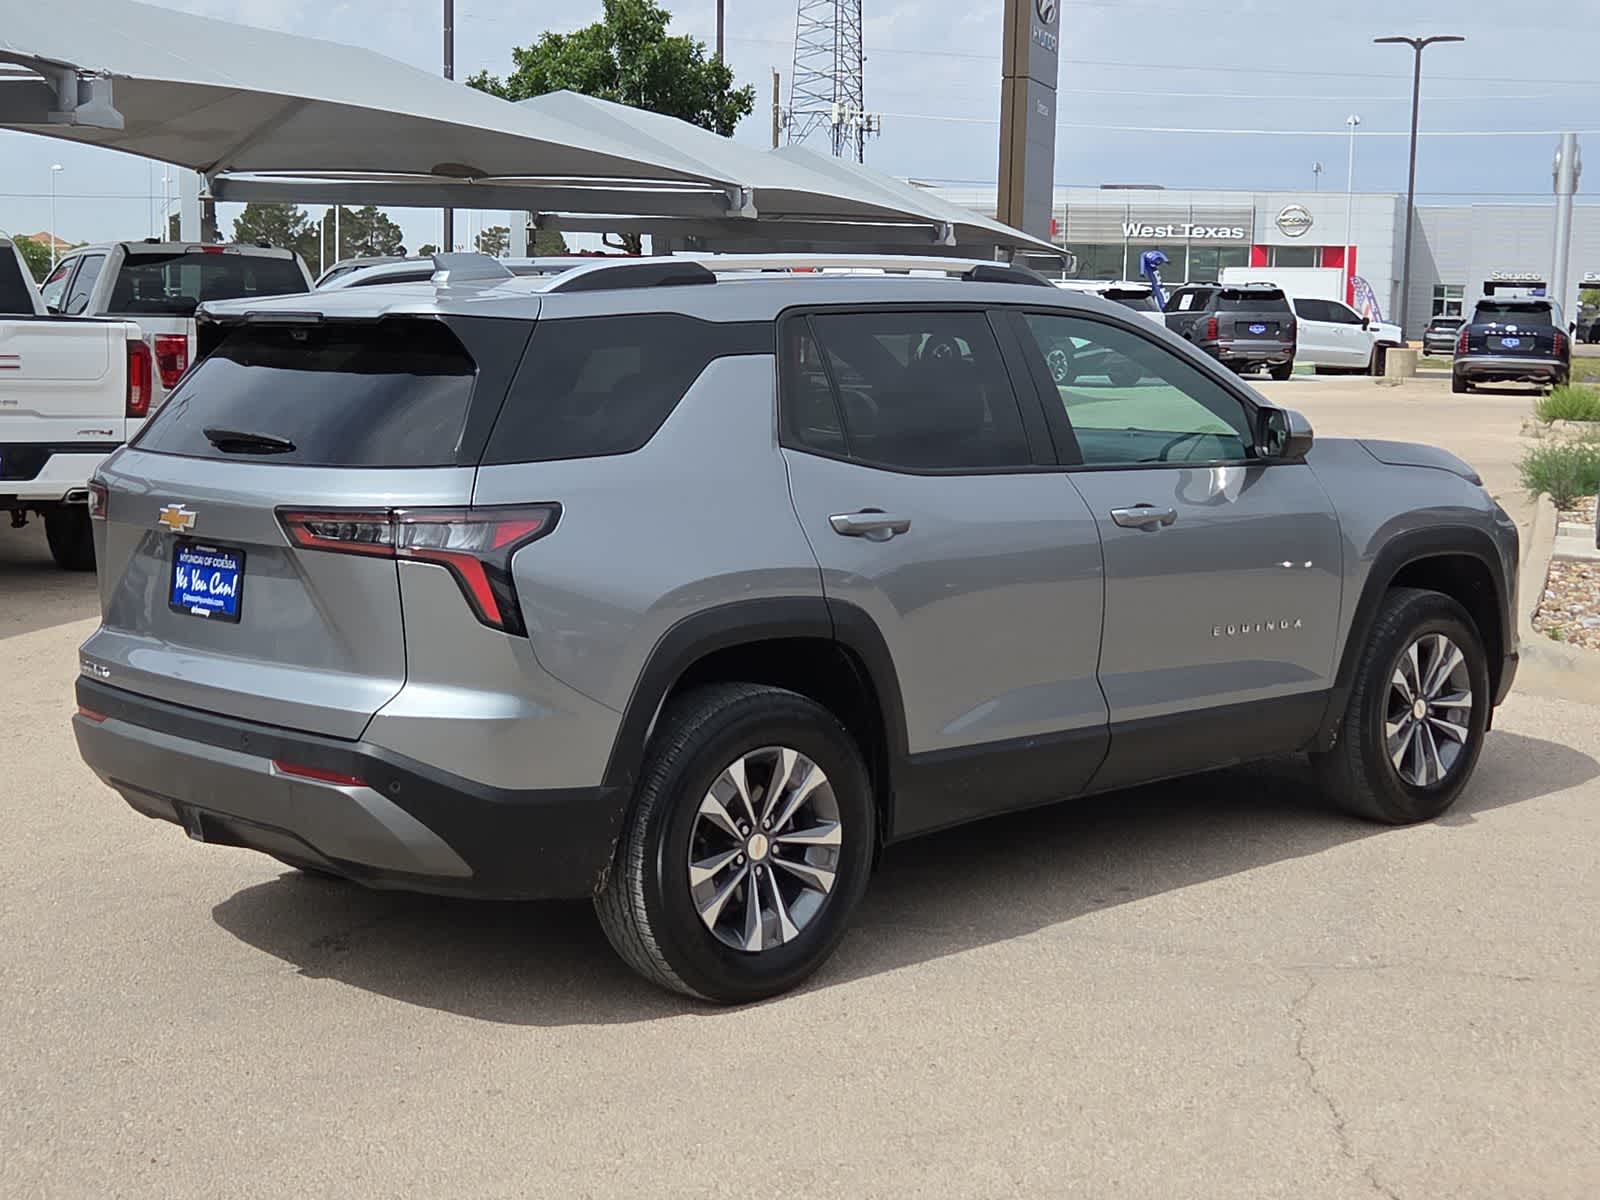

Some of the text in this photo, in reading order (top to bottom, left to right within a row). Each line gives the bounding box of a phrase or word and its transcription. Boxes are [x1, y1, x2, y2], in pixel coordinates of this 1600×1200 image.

[1122, 223, 1245, 239] West Texas
[1491, 270, 1541, 281] Service
[204, 557, 213, 567] OF
[212, 558, 237, 570] ODESSA
[175, 566, 239, 597] Yes You Can!
[1211, 617, 1303, 637] EQUINOX
